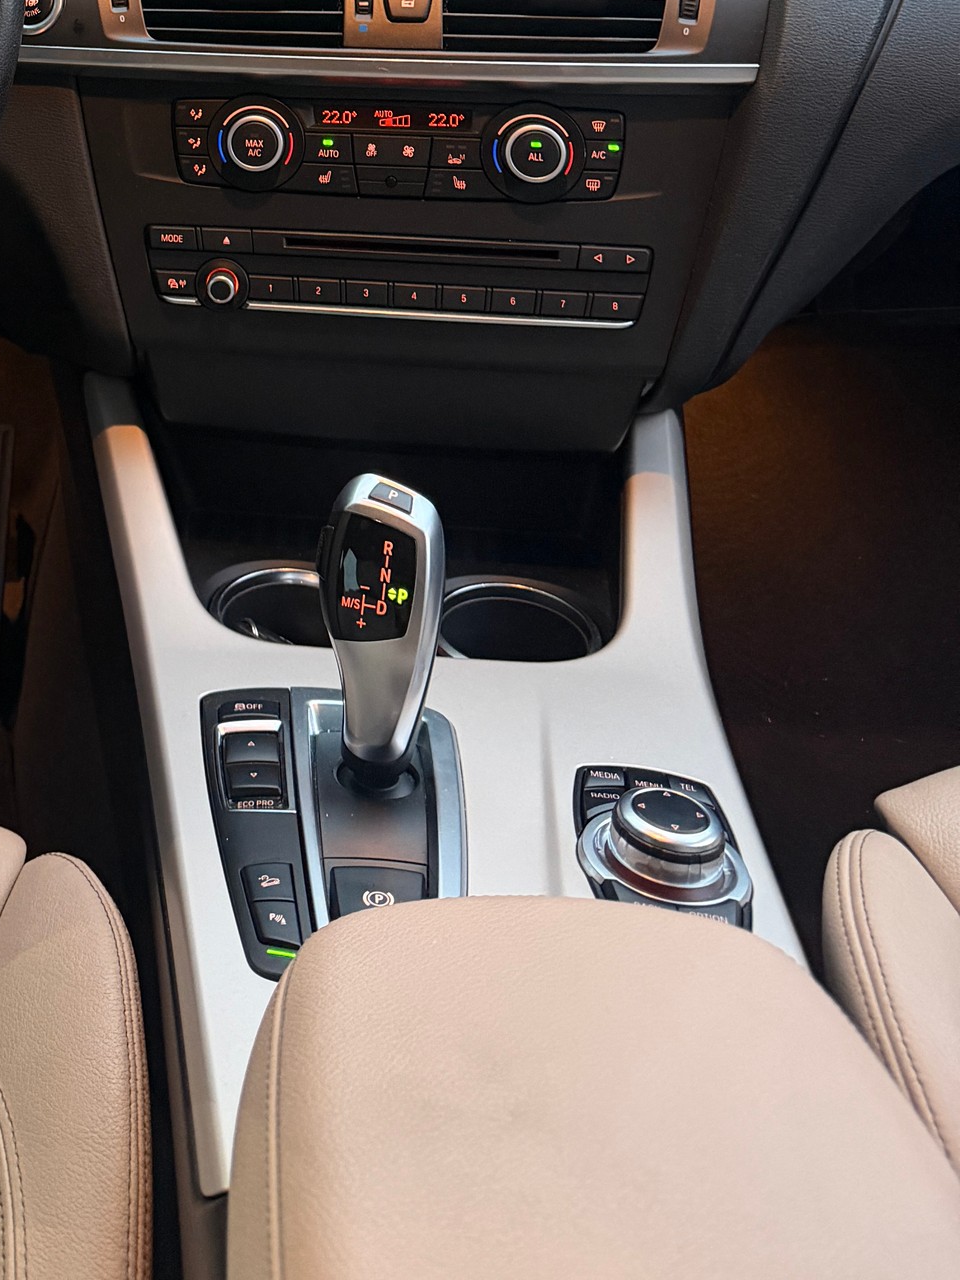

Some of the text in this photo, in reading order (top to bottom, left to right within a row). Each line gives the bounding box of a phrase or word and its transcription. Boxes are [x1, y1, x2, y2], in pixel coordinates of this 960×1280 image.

[374, 110, 393, 118] AUTO
[245, 139, 264, 148] MAX
[248, 149, 262, 157] A/C
[318, 149, 339, 158] AUTO
[366, 150, 378, 158] OFF
[528, 152, 544, 162] ALL
[591, 150, 607, 160] A/C
[161, 233, 184, 243] MODE
[315, 286, 321, 295] 2
[363, 288, 369, 297] 3
[411, 291, 417, 300] 4
[461, 294, 467, 303] 5
[510, 296, 516, 305] 6
[560, 299, 566, 308] 7
[612, 301, 619, 311] 8
[388, 489, 399, 499] P
[383, 540, 394, 556] R
[379, 568, 391, 584] N
[397, 588, 409, 605] P
[341, 596, 360, 610] M/S
[376, 600, 387, 615] D
[590, 770, 620, 780] MEDIA
[679, 783, 697, 792] TEL
[590, 792, 620, 800] RADIO
[237, 801, 254, 809] ECO
